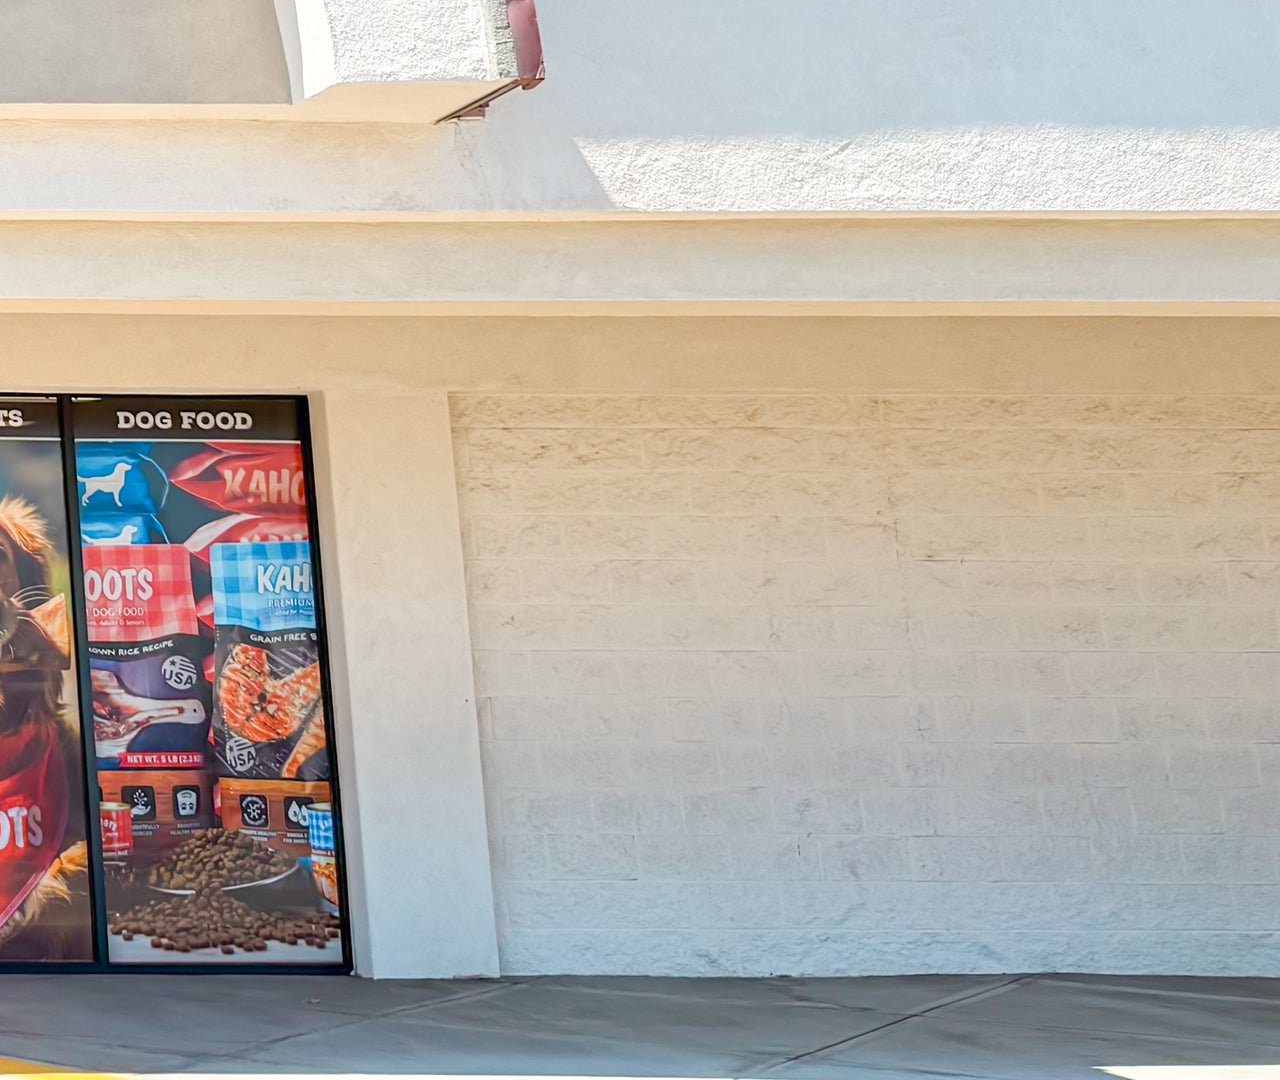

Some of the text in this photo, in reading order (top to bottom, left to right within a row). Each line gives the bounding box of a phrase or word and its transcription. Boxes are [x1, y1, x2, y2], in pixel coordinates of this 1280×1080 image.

[116, 411, 253, 430] DOG FOOD
[84, 568, 153, 602] OOTS
[257, 563, 311, 595] KAH
[93, 607, 144, 617] DOG FOOD
[249, 633, 283, 644] GRAIN
[283, 632, 308, 641] FREE
[118, 647, 140, 657] RICE
[142, 640, 174, 653] RECIPE
[163, 668, 195, 687] USA
[127, 754, 143, 763] NET
[145, 754, 160, 764] WT.
[167, 754, 179, 763] LB
[228, 751, 257, 769] USA
